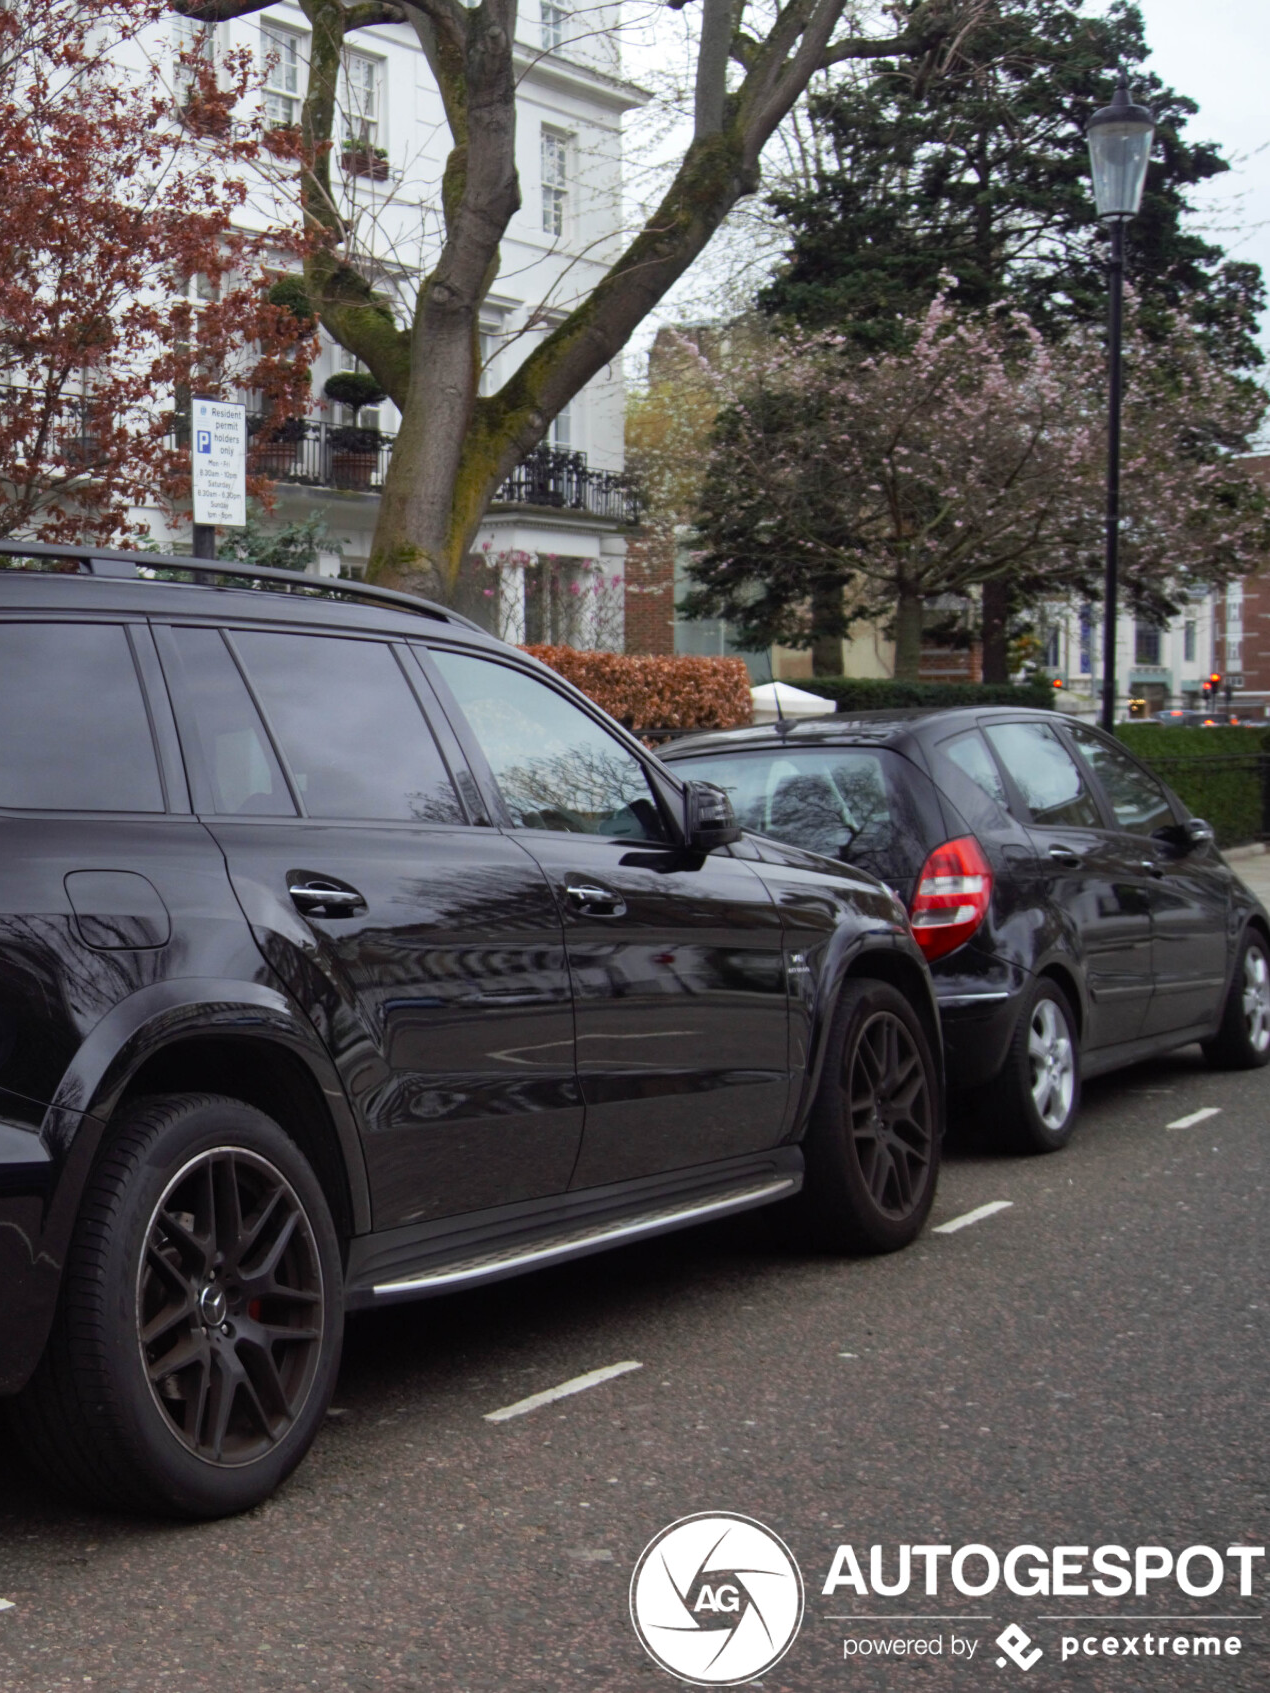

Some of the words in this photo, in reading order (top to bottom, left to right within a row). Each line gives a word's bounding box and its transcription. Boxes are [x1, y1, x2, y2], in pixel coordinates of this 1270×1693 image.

[211, 408, 241, 419] Resident
[216, 421, 238, 431] permit
[199, 431, 210, 452] P
[214, 433, 240, 444] holders
[220, 447, 233, 456] only
[208, 479, 231, 490] Saturday
[210, 500, 229, 510] Sunday
